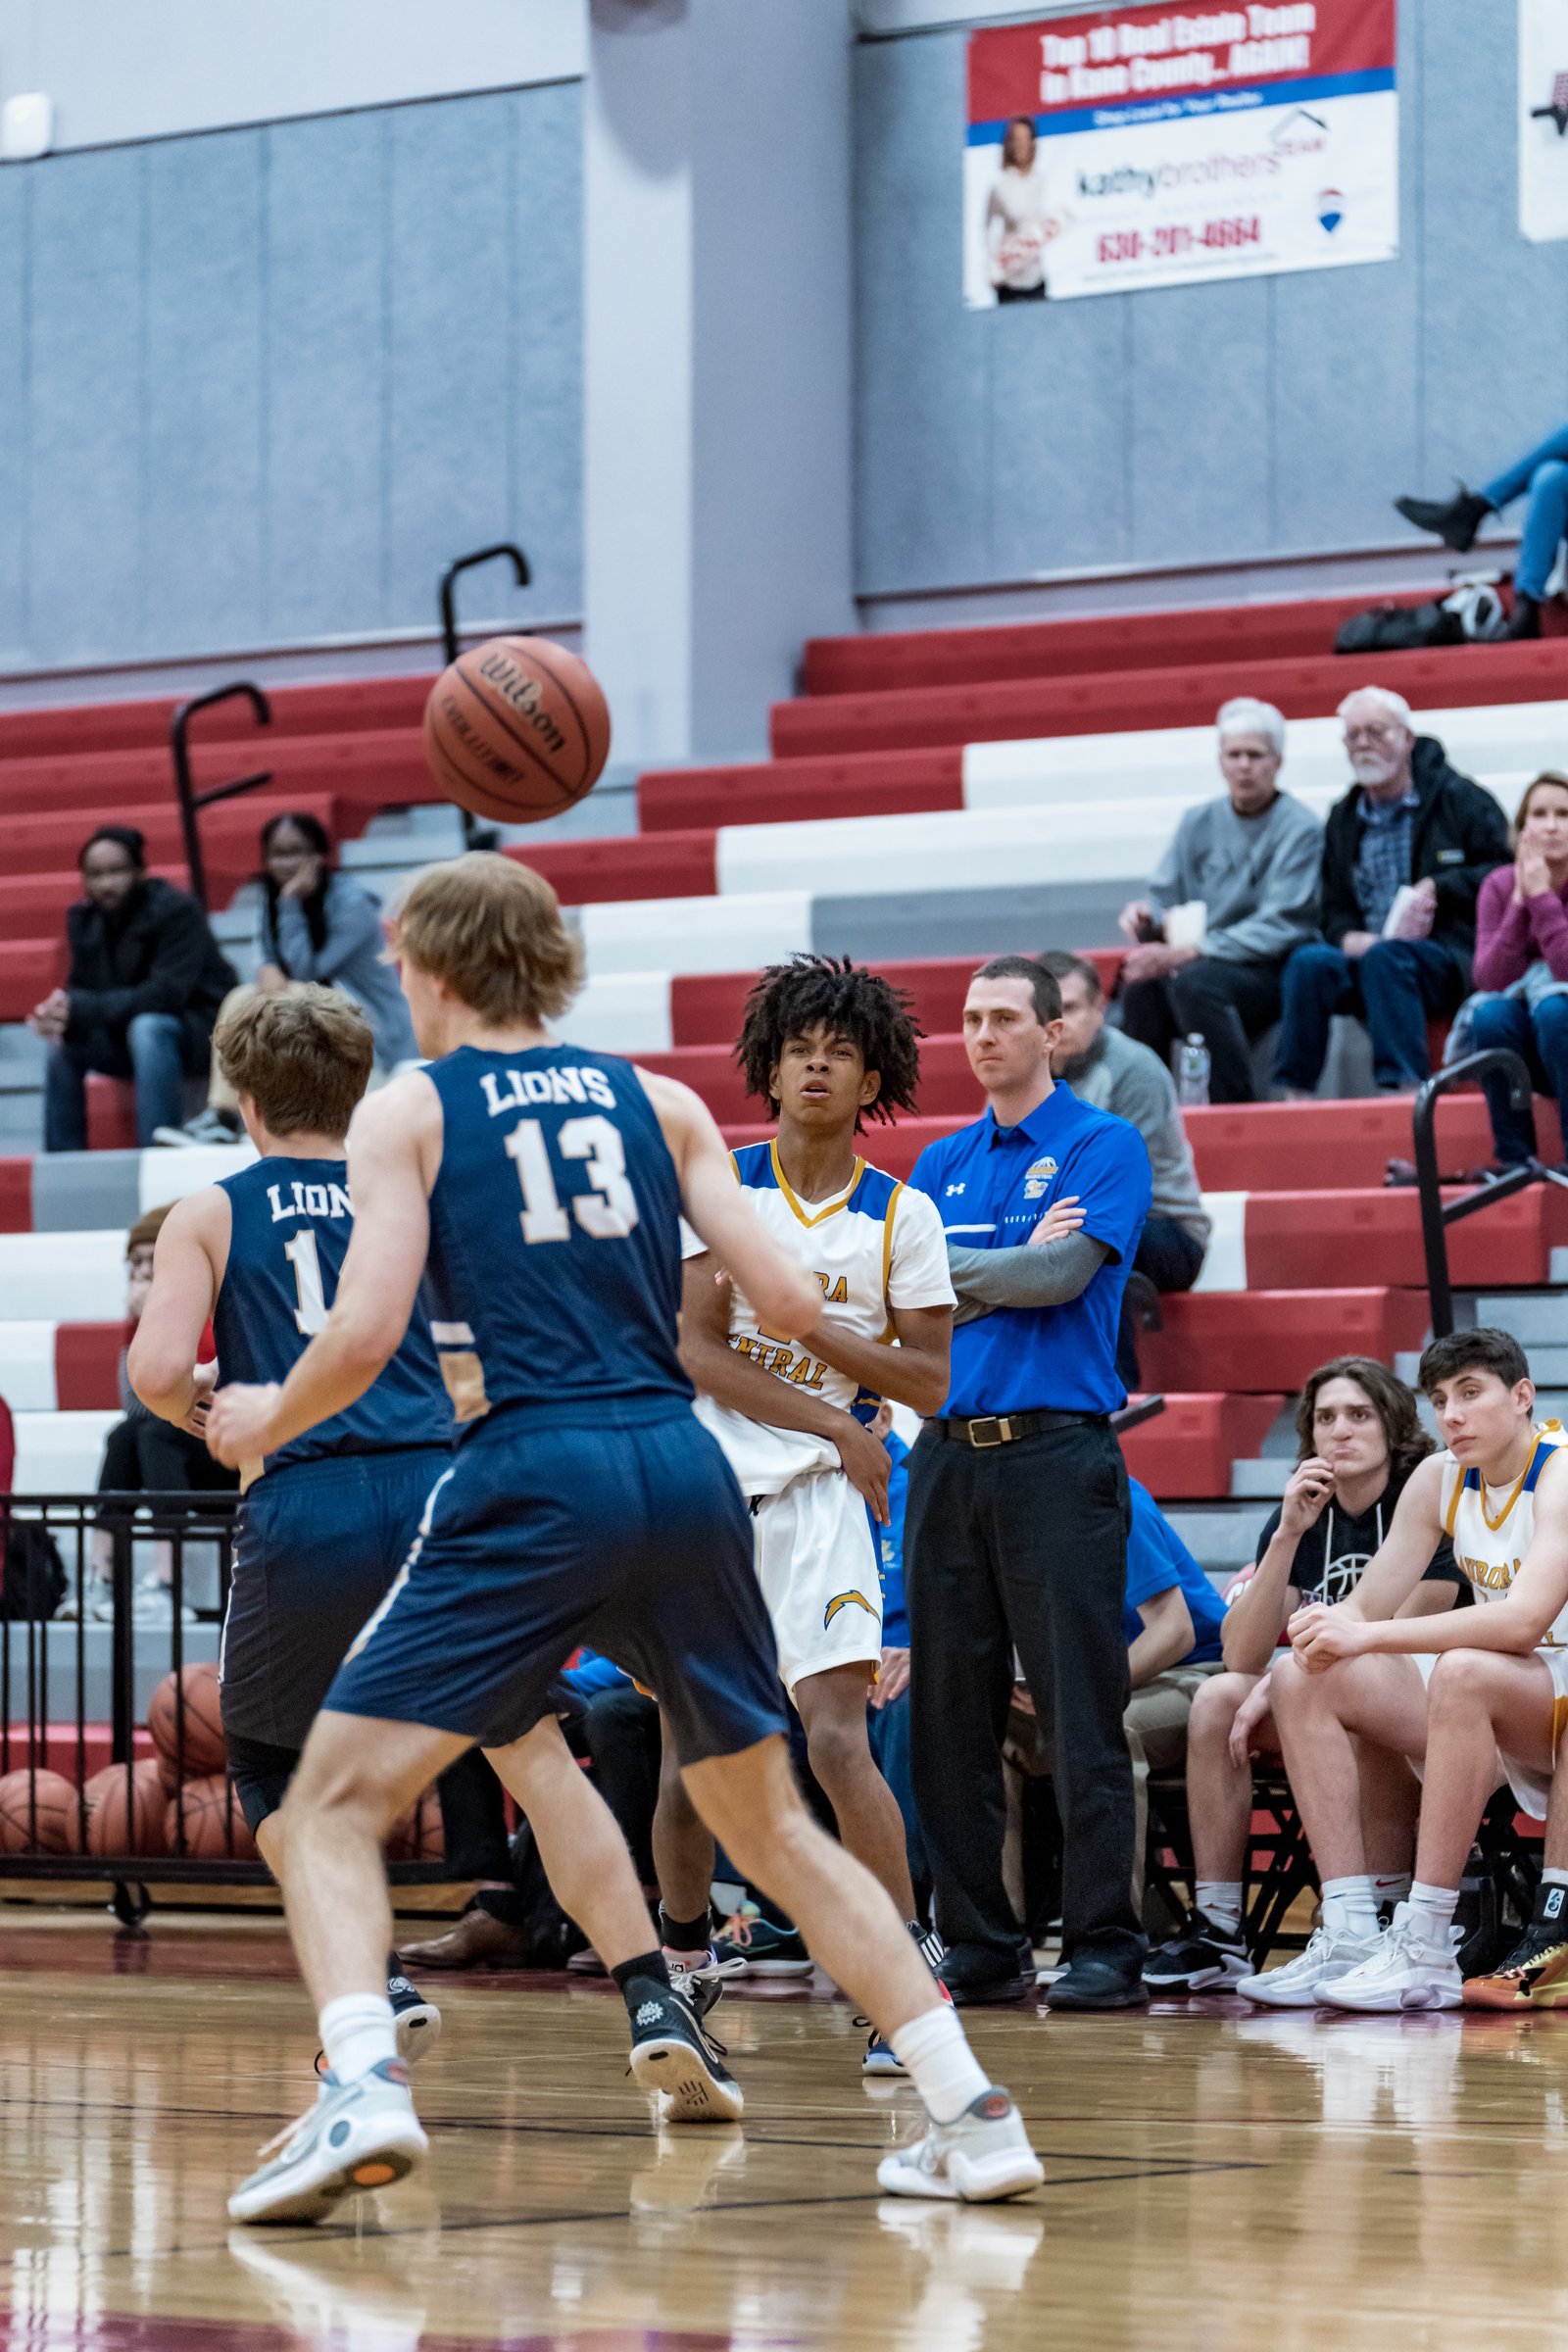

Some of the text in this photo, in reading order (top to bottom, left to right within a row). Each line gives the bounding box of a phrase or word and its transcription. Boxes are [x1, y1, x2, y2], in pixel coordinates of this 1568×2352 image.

[1041, 34, 1086, 68] Top
[1117, 19, 1172, 58] Real
[1172, 12, 1246, 50] Estate
[480, 653, 565, 753] Wilson
[479, 1066, 617, 1117] LIONS
[504, 1114, 640, 1245] 13
